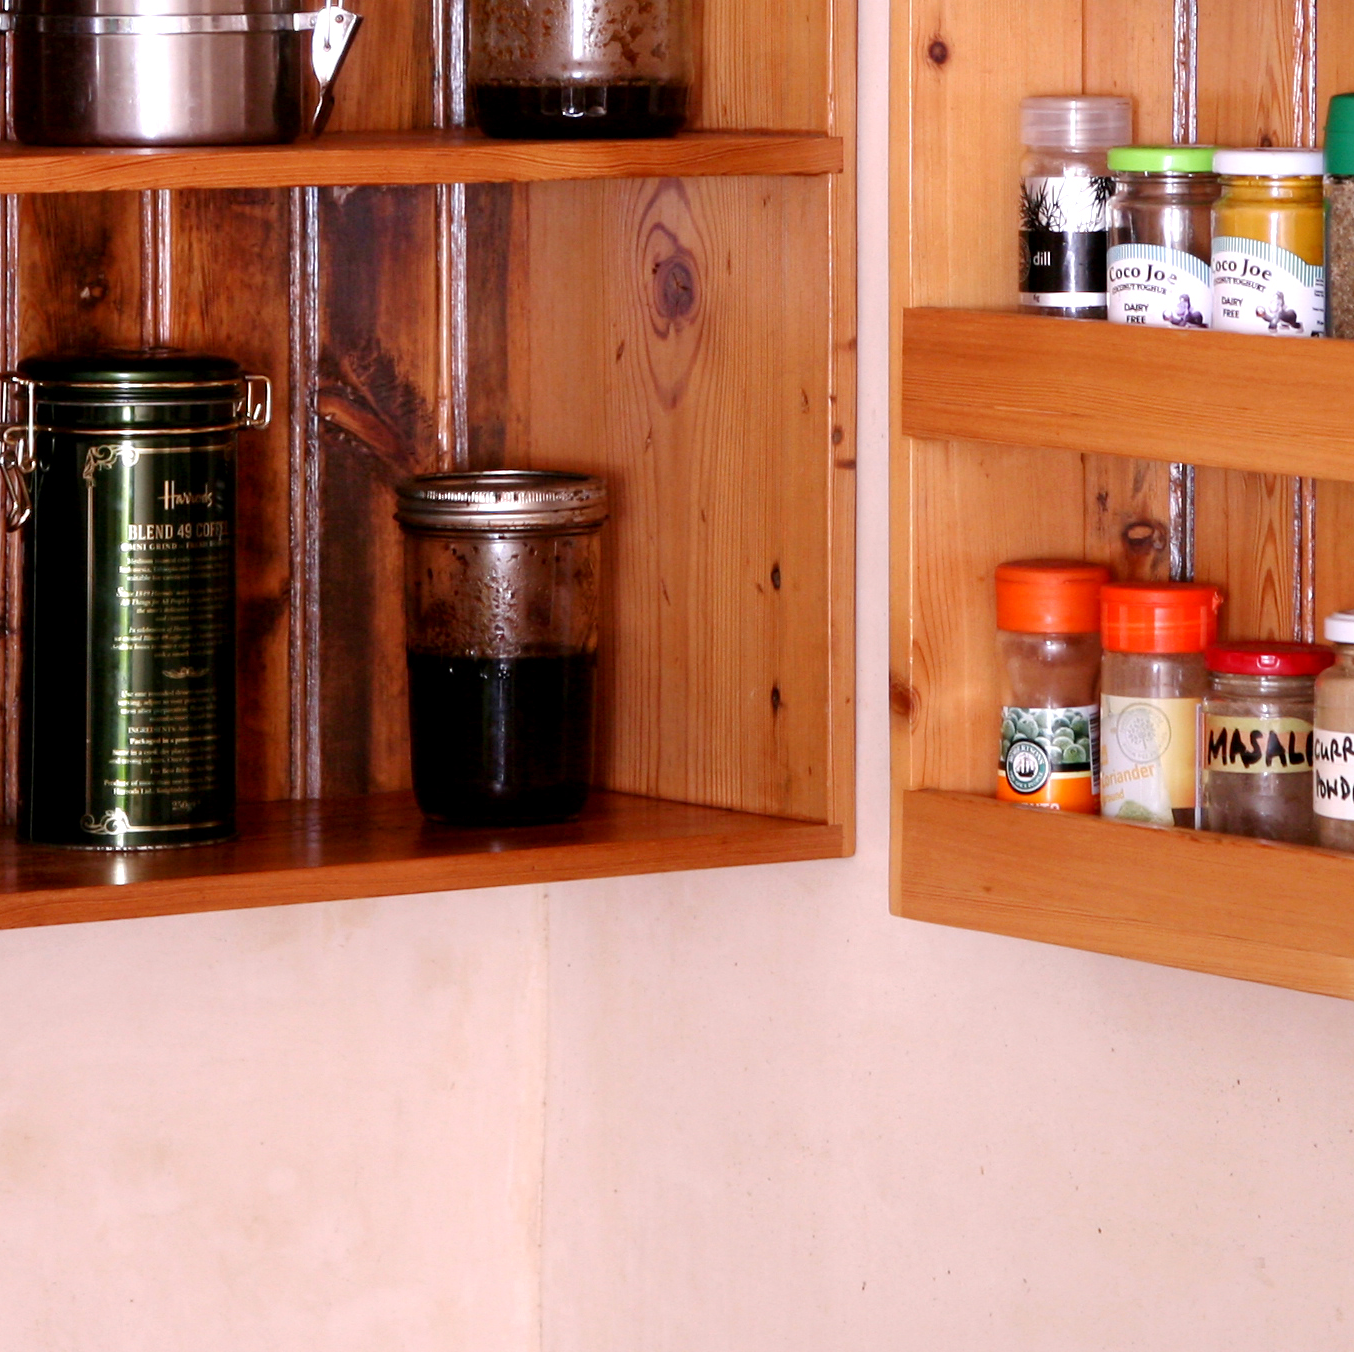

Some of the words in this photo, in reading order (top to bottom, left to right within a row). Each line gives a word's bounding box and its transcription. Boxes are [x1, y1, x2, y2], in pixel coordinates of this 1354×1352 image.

[1032, 251, 1052, 266] dill
[1109, 265, 1141, 282] Coco
[1145, 264, 1178, 285] Joe
[1240, 258, 1273, 282] Joe
[1123, 302, 1149, 313] DAIRY
[1221, 296, 1244, 307] DAIRY
[1126, 315, 1146, 325] FREE
[1223, 308, 1240, 319] FREE
[157, 480, 213, 510] Harrods
[128, 523, 174, 541] BLEND
[177, 522, 193, 540] 49
[148, 542, 178, 551] GRIND
